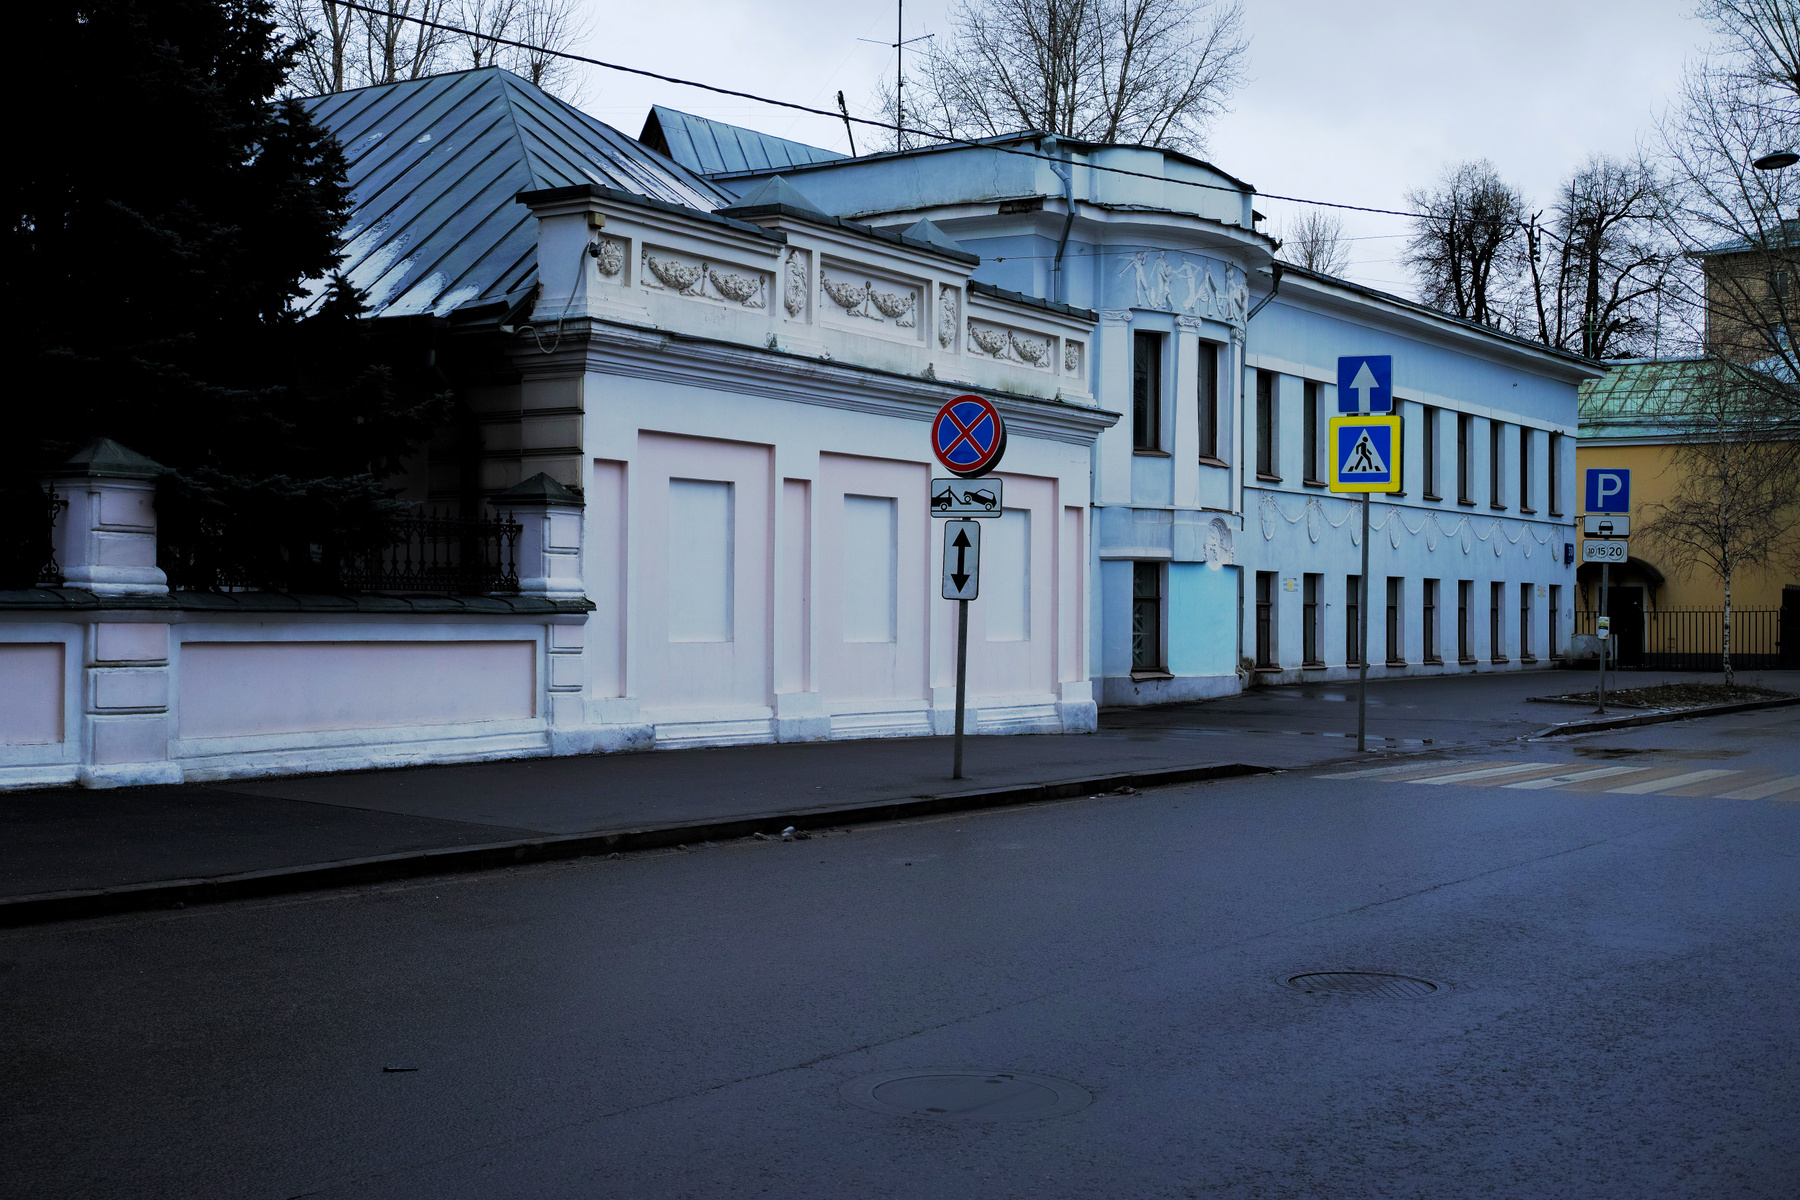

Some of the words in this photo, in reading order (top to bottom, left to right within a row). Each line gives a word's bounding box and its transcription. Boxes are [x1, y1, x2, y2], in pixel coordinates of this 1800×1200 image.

[1597, 473, 1622, 508] P
[1597, 547, 1605, 555] 15
[1609, 547, 1622, 556] 20
